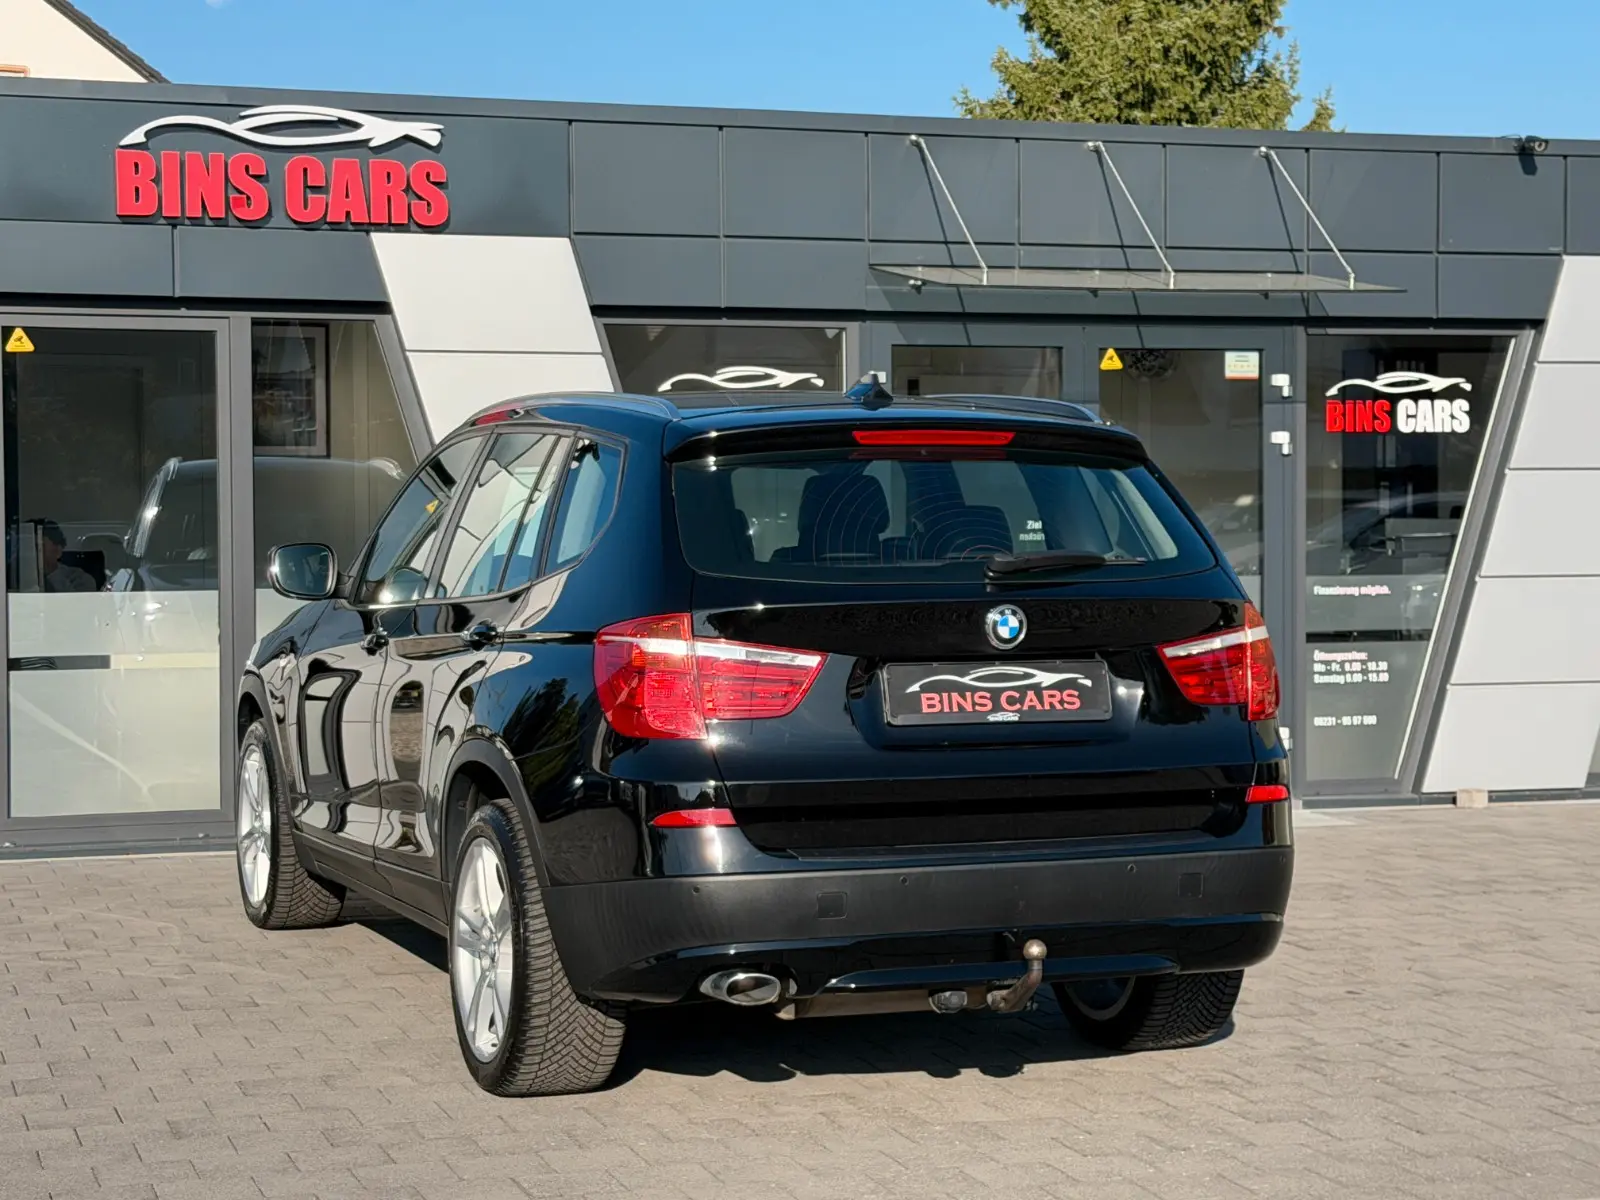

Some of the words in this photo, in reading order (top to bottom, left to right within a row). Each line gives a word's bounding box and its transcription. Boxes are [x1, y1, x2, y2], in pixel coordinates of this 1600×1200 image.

[115, 149, 270, 222] BINS
[285, 154, 450, 227] CARS
[1325, 399, 1391, 433] BINS
[1397, 399, 1471, 433] CARS
[920, 691, 993, 714] BINS
[1000, 690, 1081, 711] CARS
